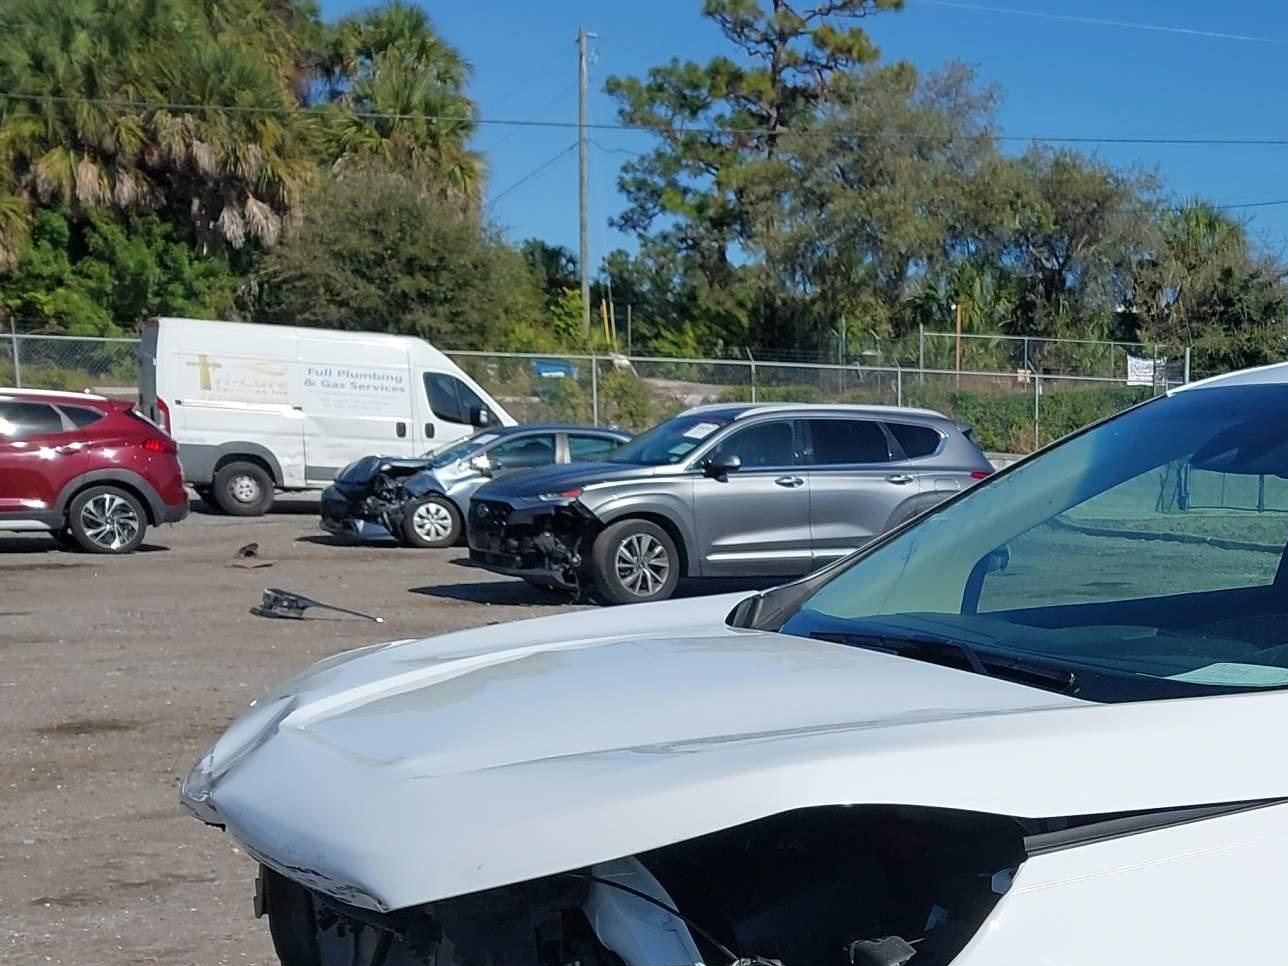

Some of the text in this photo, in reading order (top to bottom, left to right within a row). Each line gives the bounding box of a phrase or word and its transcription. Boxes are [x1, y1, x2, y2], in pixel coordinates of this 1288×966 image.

[307, 367, 403, 384] Full Plumbing
[304, 378, 405, 392] & Gas Services
